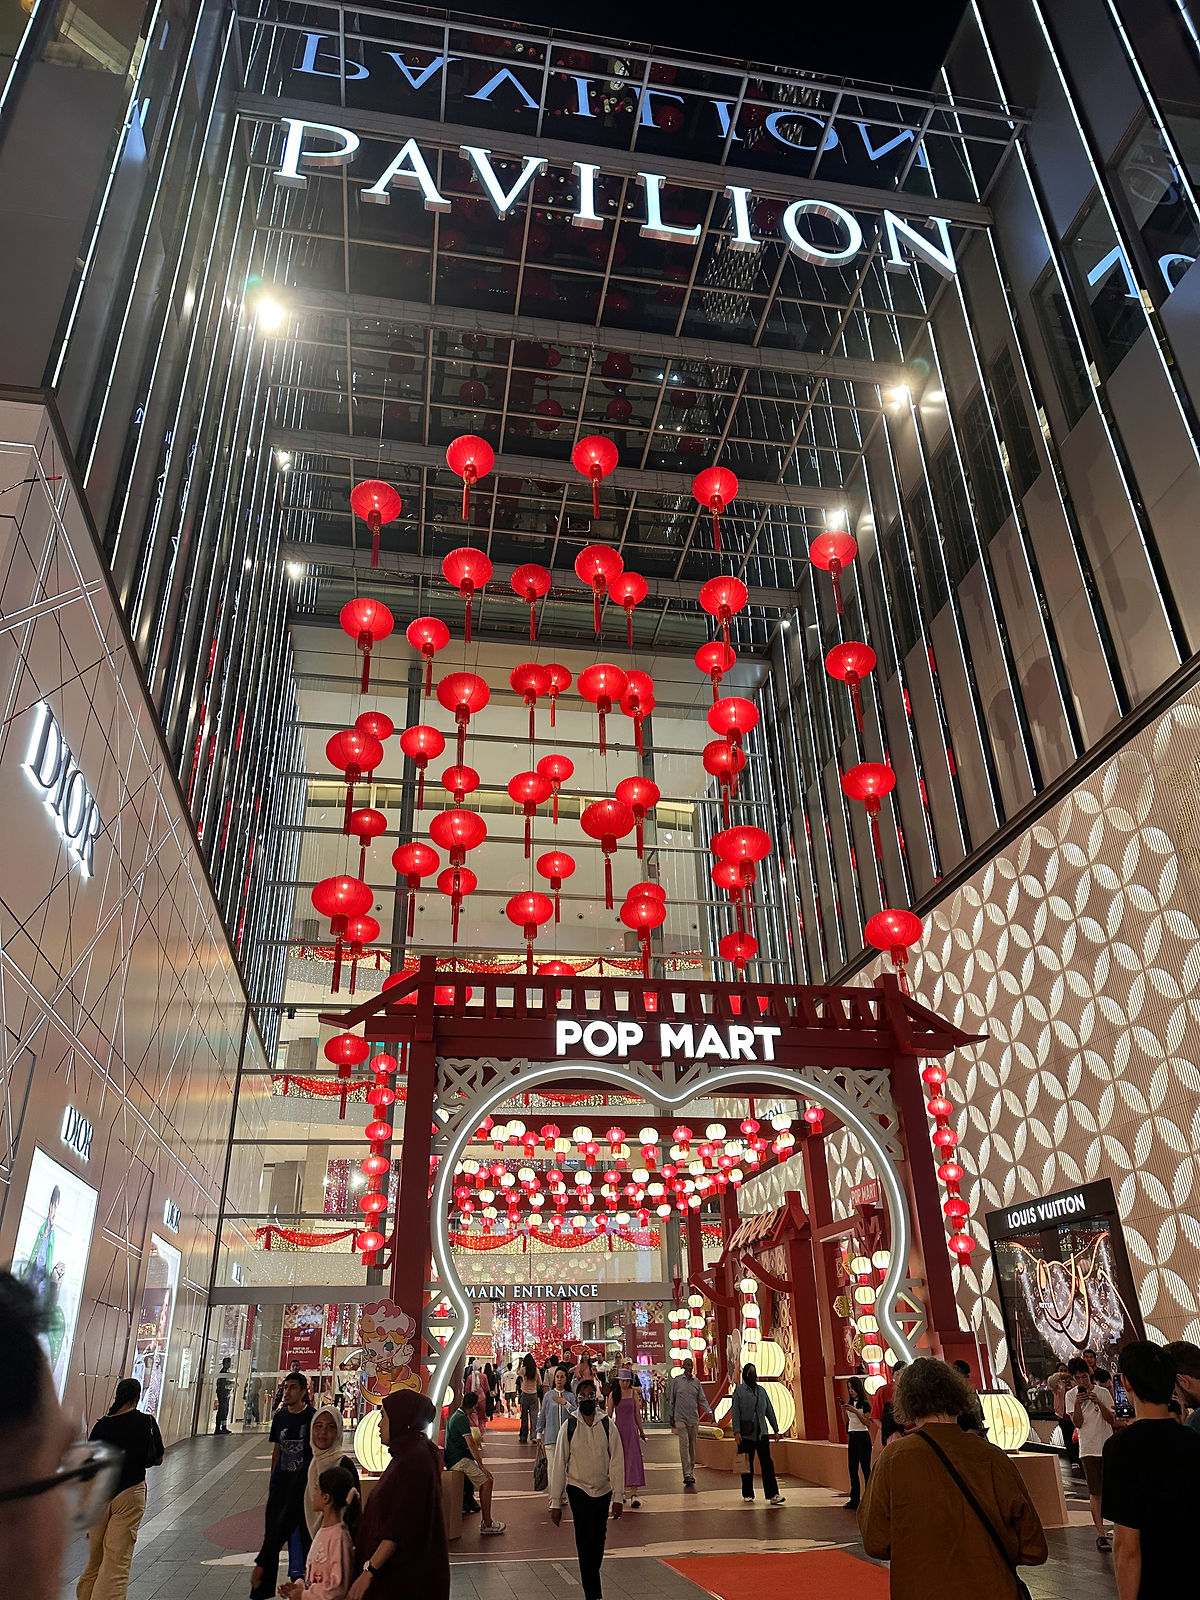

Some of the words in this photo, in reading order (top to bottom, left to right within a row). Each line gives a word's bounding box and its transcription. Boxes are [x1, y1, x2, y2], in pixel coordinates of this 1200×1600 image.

[273, 117, 957, 280] PAVILION
[22, 702, 101, 877] DIOR
[555, 1019, 644, 1057] POP
[659, 1022, 782, 1061] MART
[60, 1104, 94, 1161] DIOR
[851, 1189, 862, 1204] POP
[862, 1184, 876, 1201] MART
[1007, 1205, 1037, 1229] LOUIS
[1036, 1193, 1086, 1221] VUITTON
[464, 1285, 506, 1298] MAIN
[513, 1284, 599, 1298] ENTRANCE
